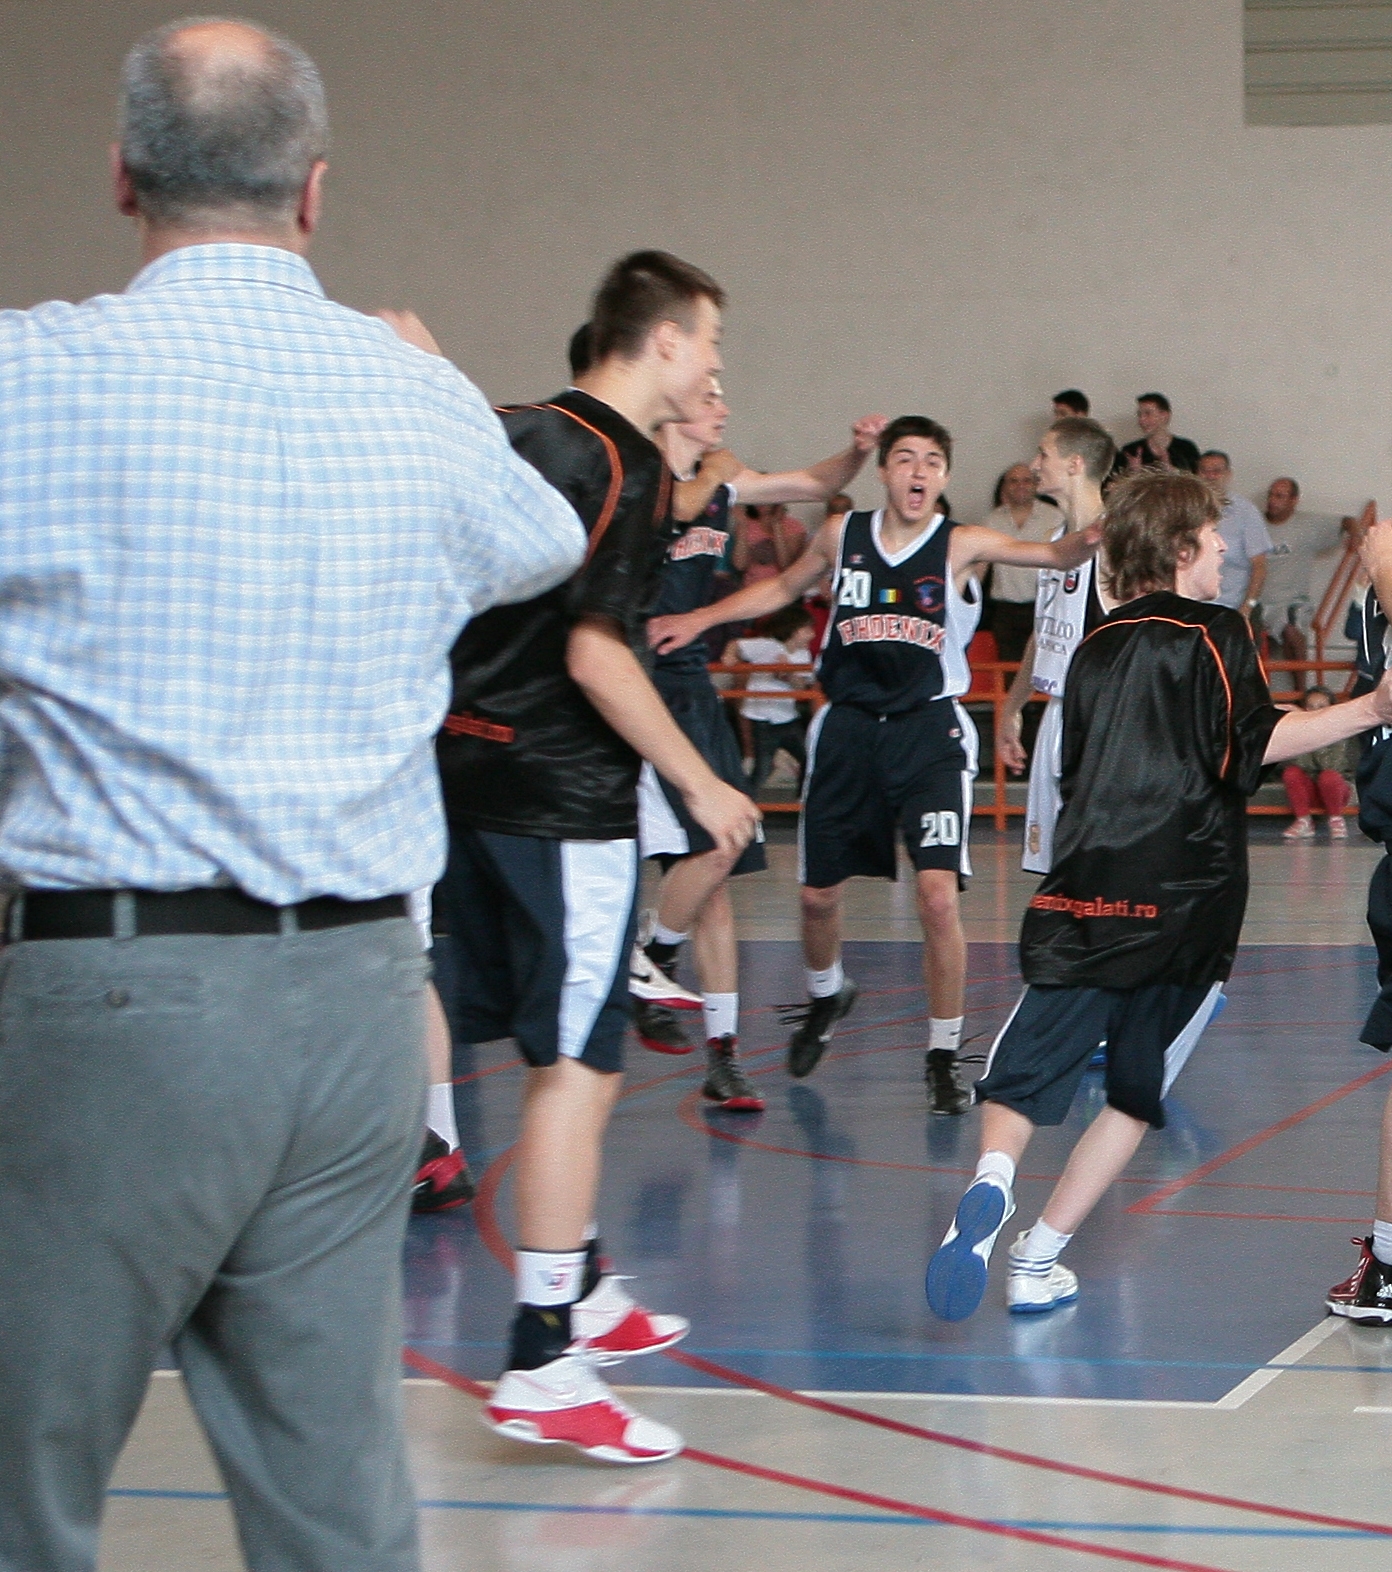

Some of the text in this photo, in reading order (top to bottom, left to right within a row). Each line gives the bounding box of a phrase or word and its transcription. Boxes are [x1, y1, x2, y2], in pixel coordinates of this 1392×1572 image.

[839, 567, 872, 608] 20
[837, 614, 946, 654] PHOENIX
[920, 810, 961, 848] 20
